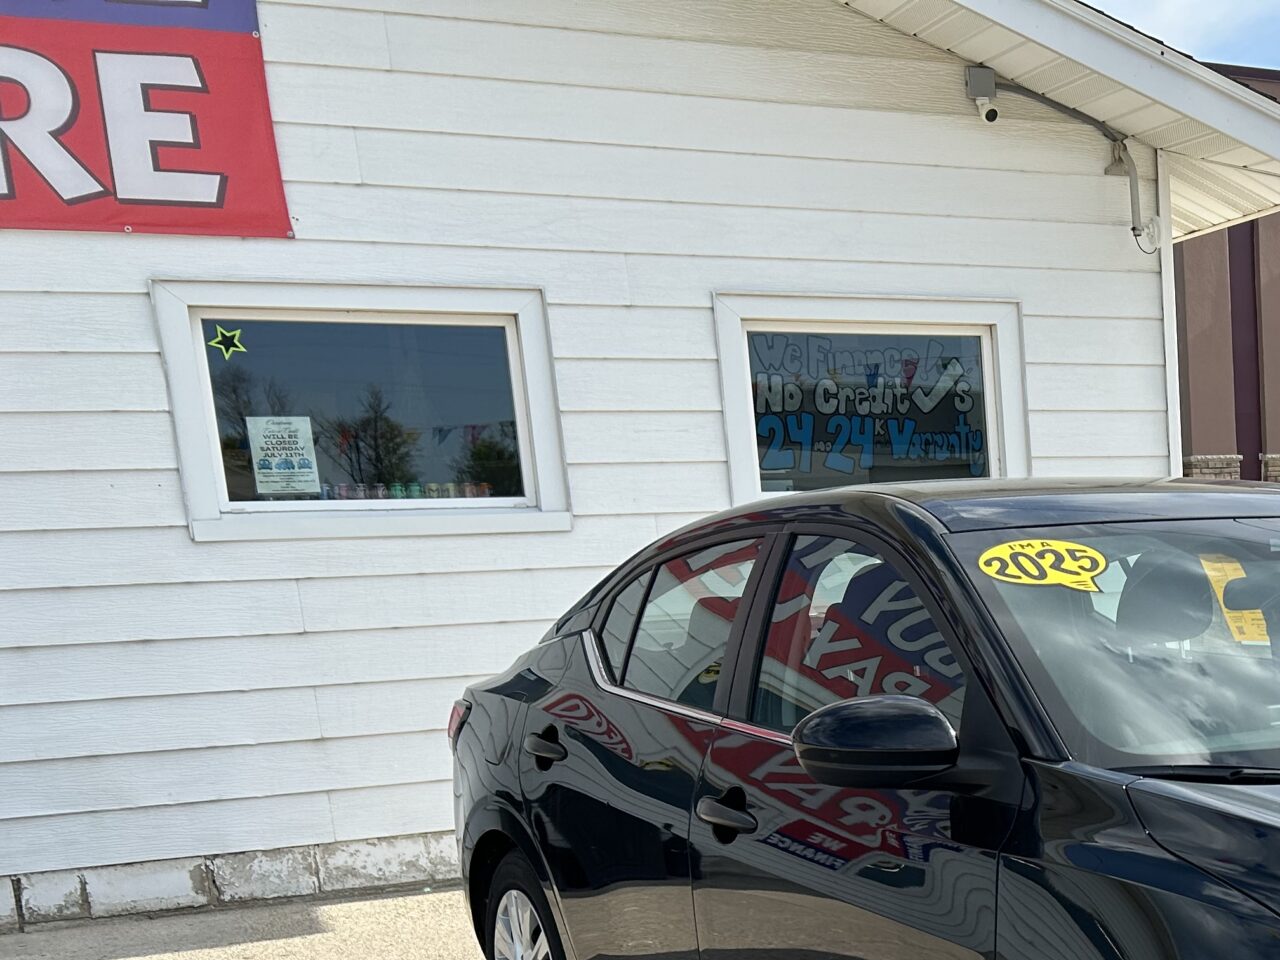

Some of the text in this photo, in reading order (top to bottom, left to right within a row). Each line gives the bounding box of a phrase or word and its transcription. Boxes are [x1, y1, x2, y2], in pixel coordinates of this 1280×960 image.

[752, 334, 802, 374] We
[755, 372, 804, 414] No
[814, 376, 911, 415] Credit
[756, 411, 815, 474] 24
[823, 413, 875, 475] 24
[983, 548, 1100, 581] 2025
[1007, 542, 1036, 551] I'M
